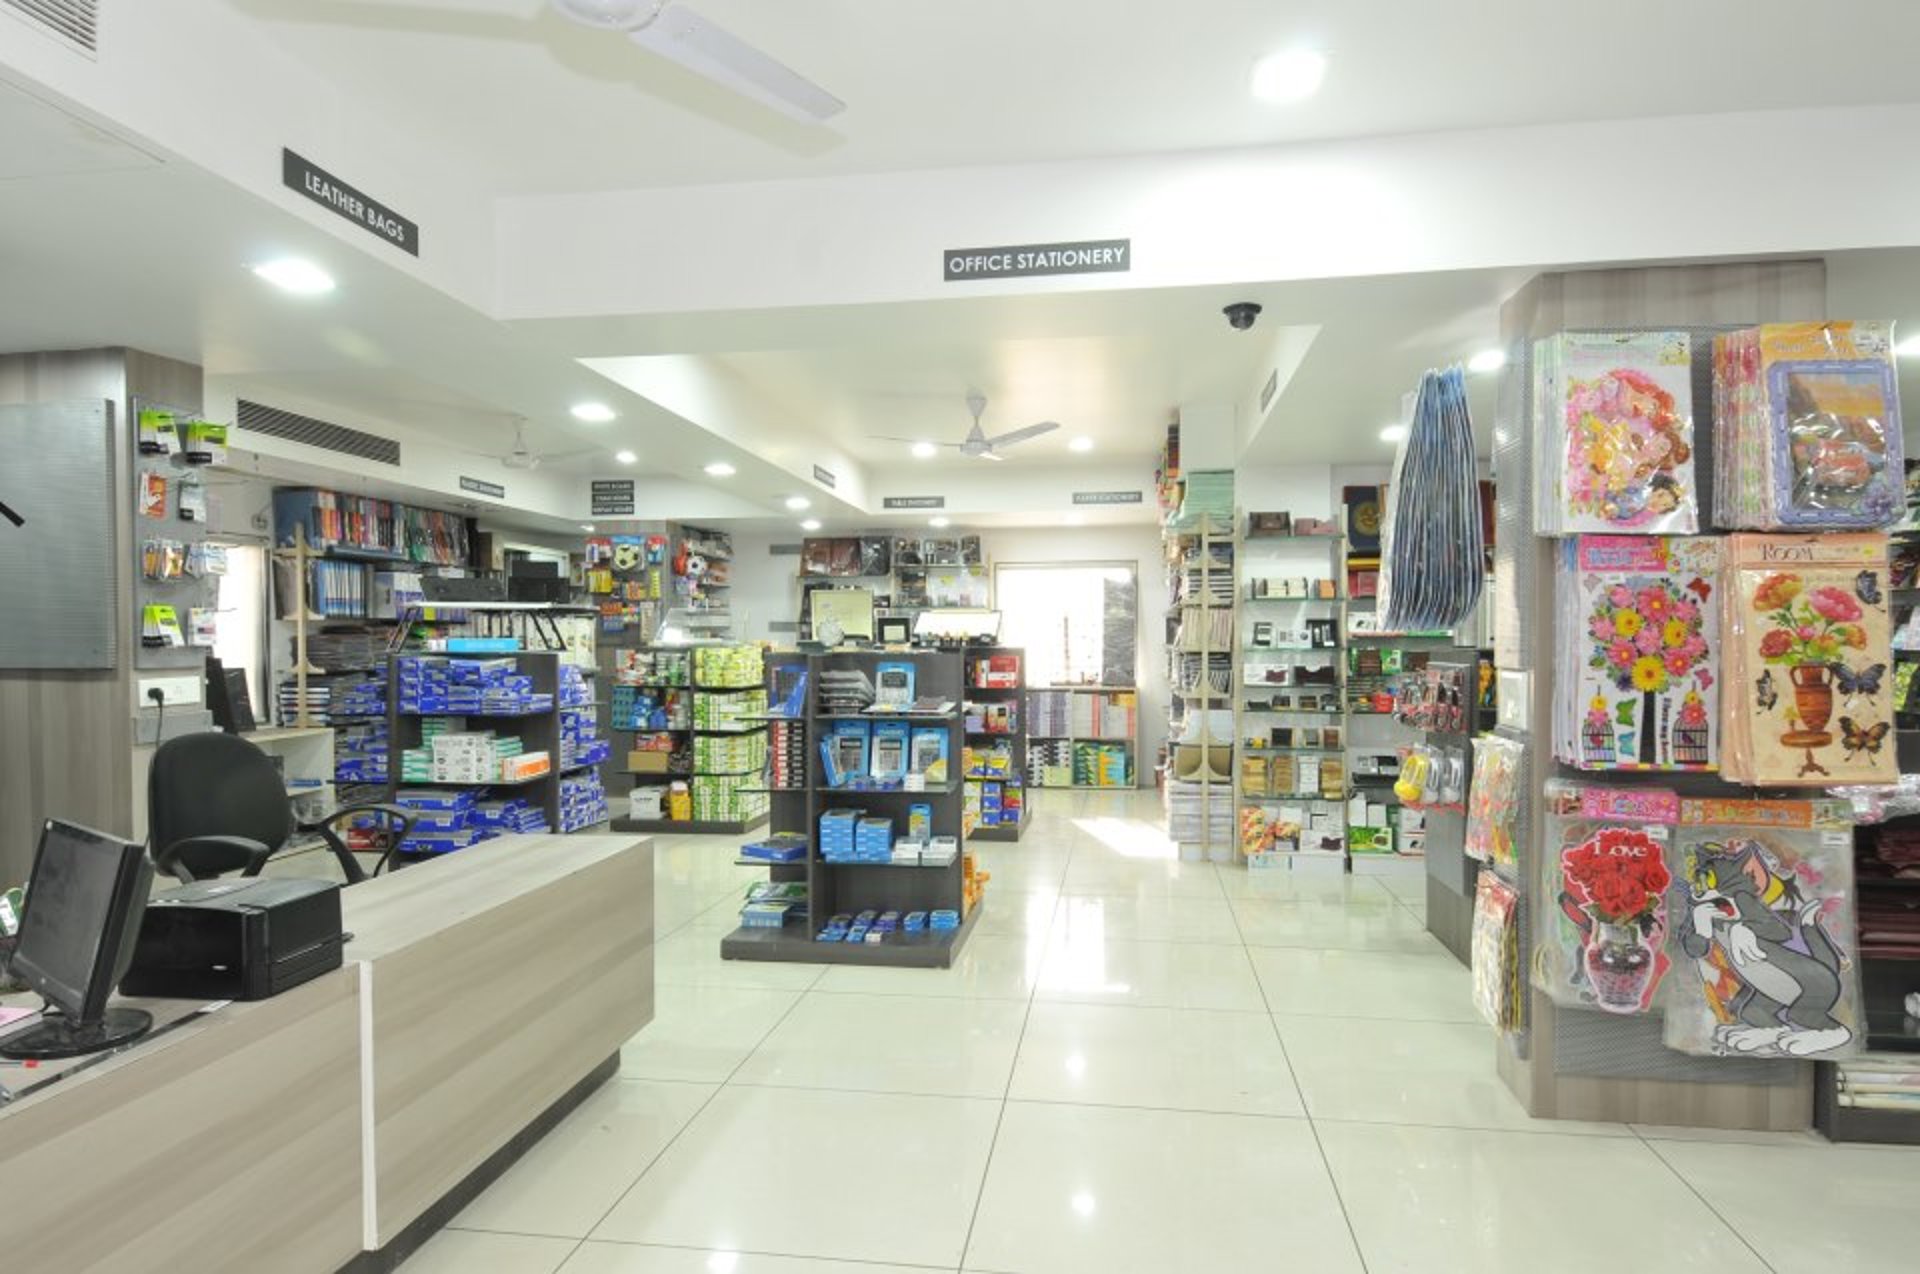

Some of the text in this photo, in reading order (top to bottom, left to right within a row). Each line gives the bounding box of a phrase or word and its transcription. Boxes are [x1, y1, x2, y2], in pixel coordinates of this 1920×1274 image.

[304, 170, 405, 242] LEATHER BAGS
[949, 246, 1126, 273] OFFICE STATIONERY
